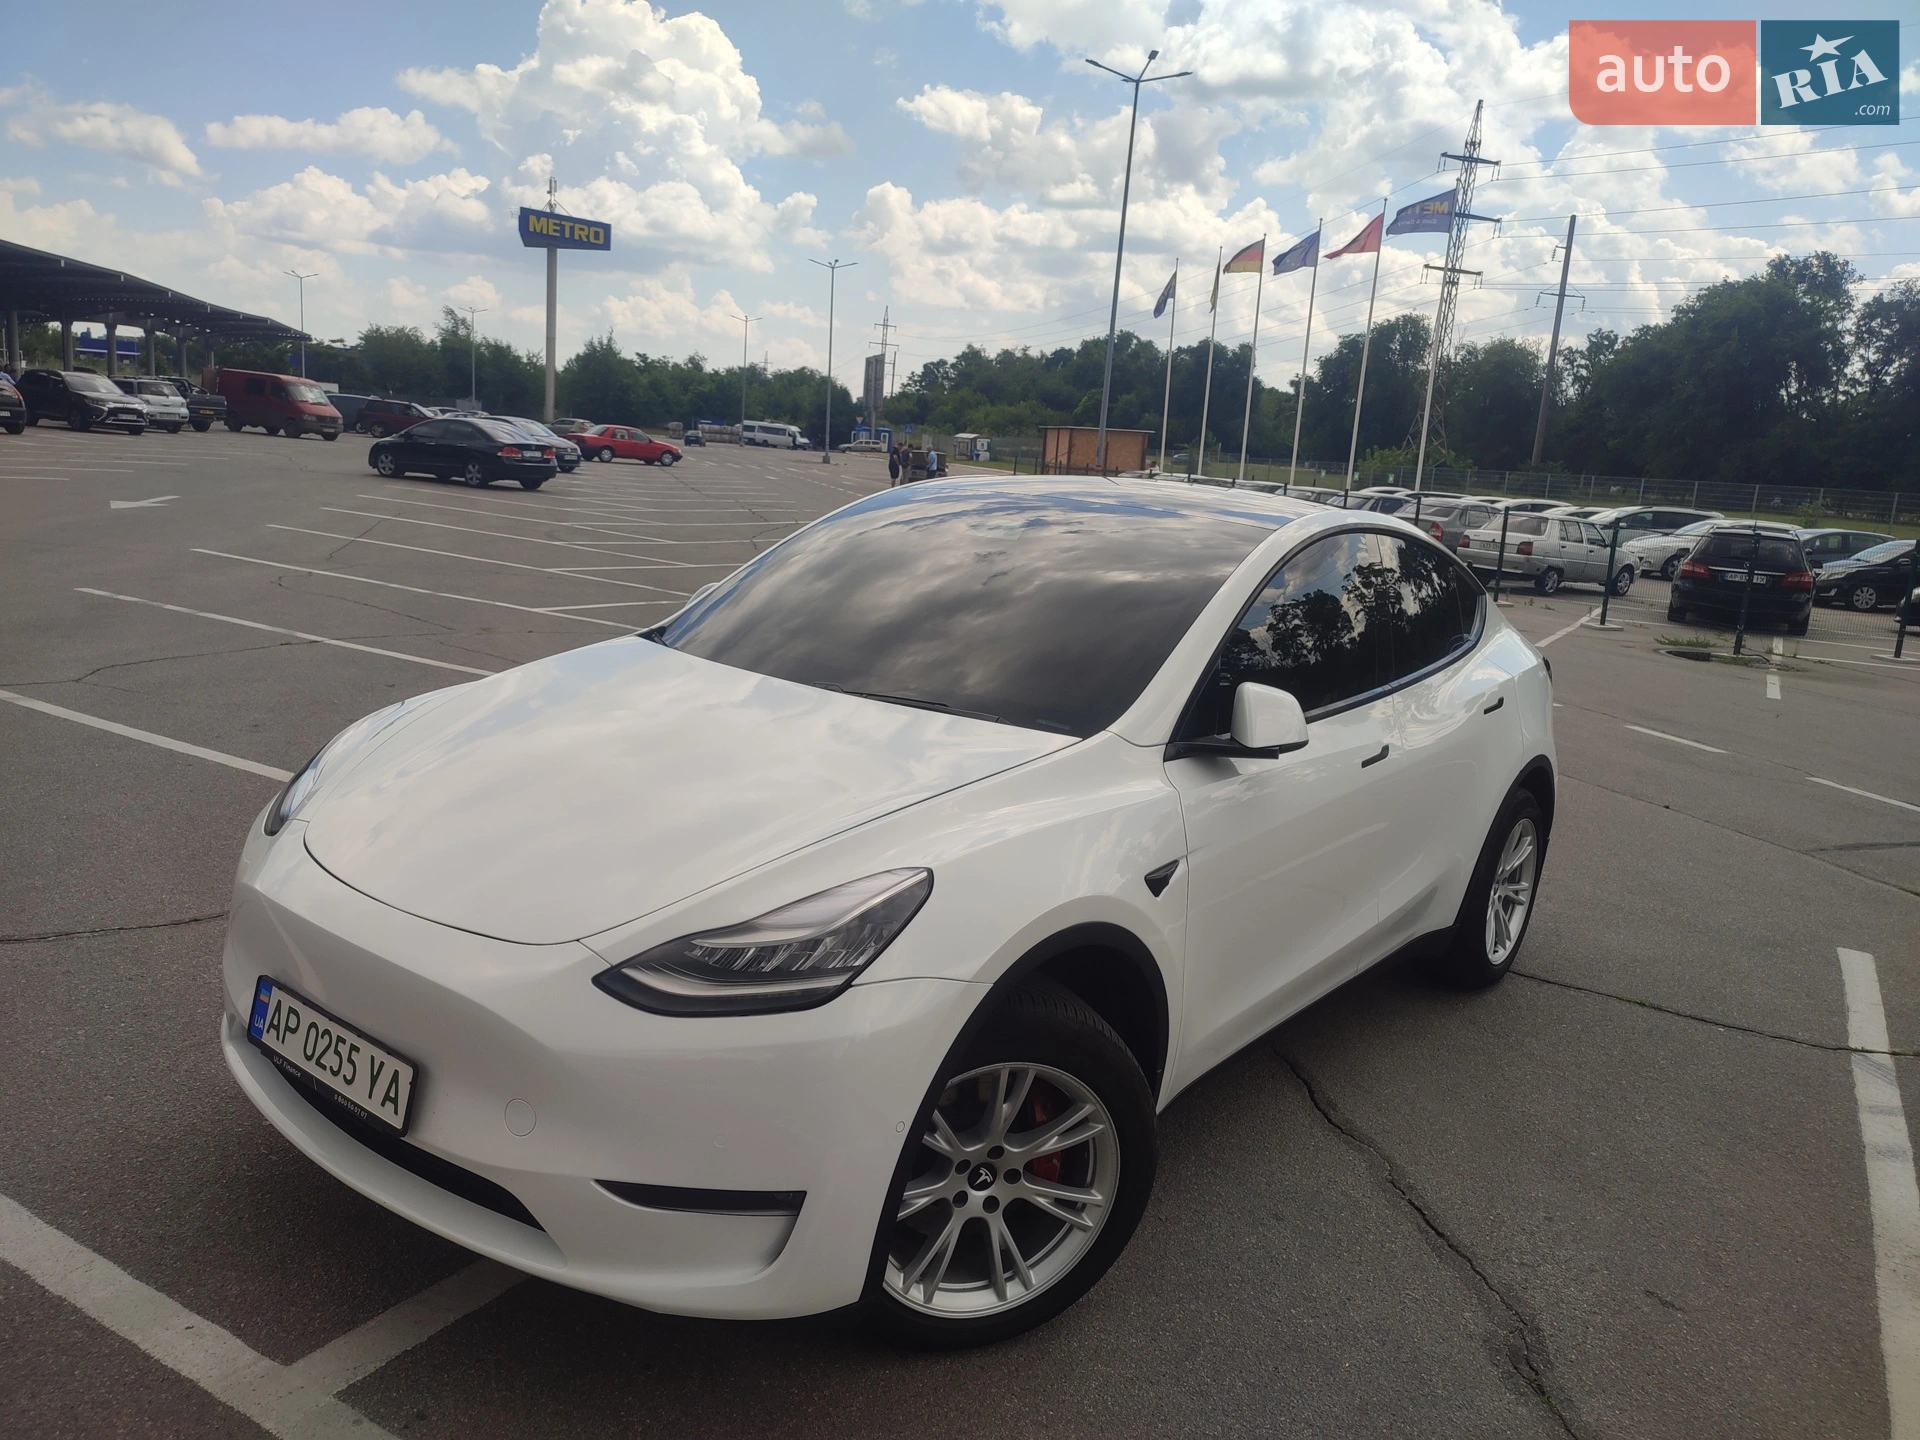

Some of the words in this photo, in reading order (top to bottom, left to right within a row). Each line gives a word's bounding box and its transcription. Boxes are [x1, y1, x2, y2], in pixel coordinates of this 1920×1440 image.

[528, 214, 605, 245] METRO
[254, 1014, 264, 1030] UA
[266, 999, 300, 1044] AP
[303, 1021, 361, 1086] 0255
[368, 1054, 400, 1116] YA
